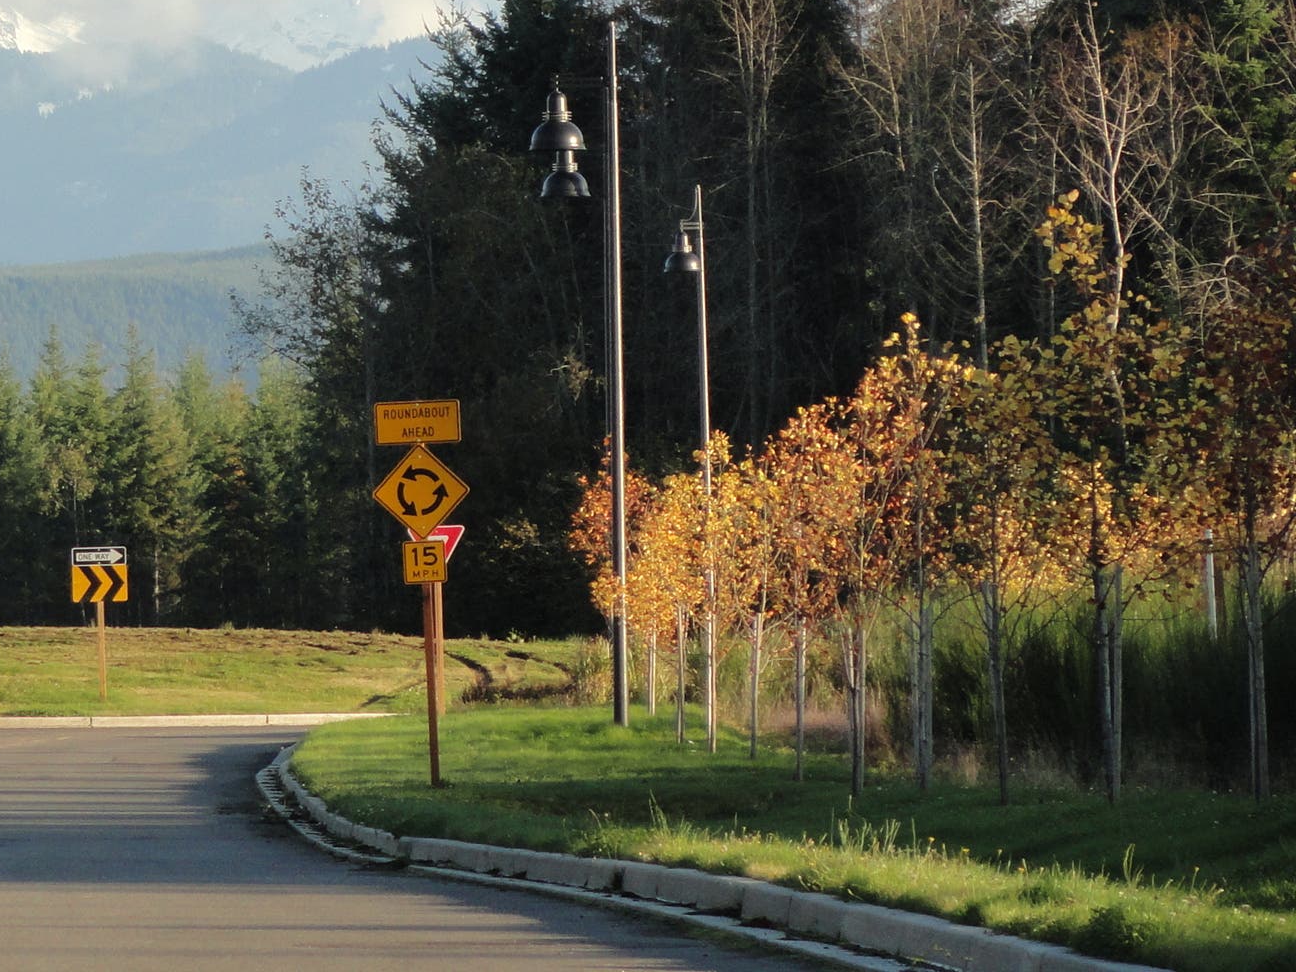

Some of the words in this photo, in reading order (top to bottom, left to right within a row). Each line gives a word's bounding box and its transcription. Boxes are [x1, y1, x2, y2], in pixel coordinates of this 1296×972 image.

[383, 406, 450, 420] ROUNDABOUT
[401, 426, 435, 438] AHEAD
[78, 553, 93, 561] ONE
[411, 546, 438, 566] 15
[413, 570, 439, 578] MPH
